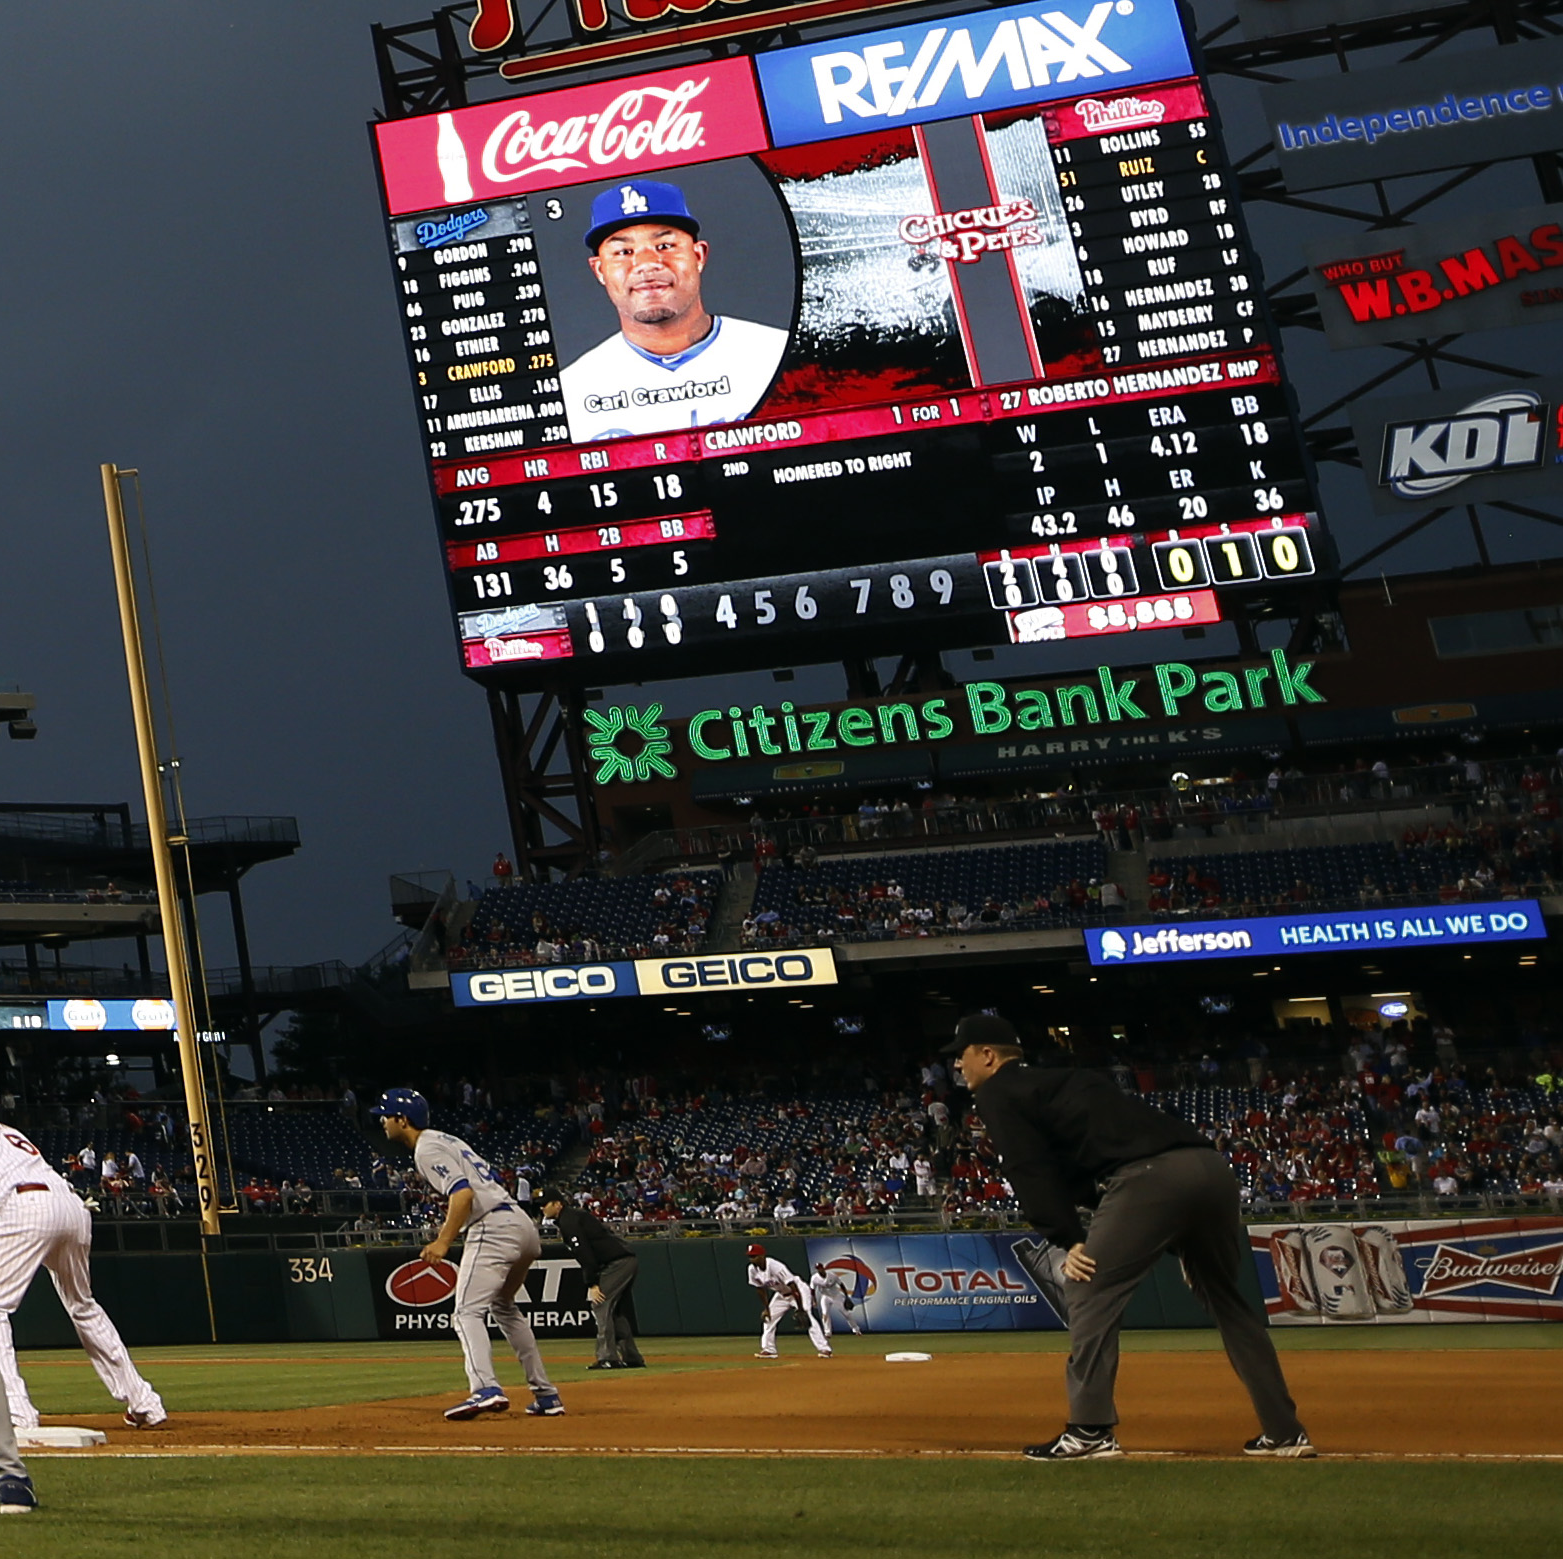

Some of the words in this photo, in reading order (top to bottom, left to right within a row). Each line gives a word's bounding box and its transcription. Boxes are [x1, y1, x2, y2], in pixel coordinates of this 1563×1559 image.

[1075, 97, 1165, 132] Phillies
[1278, 86, 1553, 150] Independence
[482, 76, 706, 183] Coca-Cola
[1054, 148, 1072, 163] 11
[1100, 129, 1161, 154] ROLLINS
[1060, 172, 1077, 187] 51
[1119, 158, 1154, 177] RUIZ
[1065, 196, 1085, 211] 26
[1121, 181, 1165, 202] UTLEY
[416, 207, 489, 248] Dodgers
[899, 199, 1038, 244] CHICKIE'S
[1130, 208, 1169, 228] BYRD
[434, 243, 488, 265] GORDON
[938, 241, 959, 260] &
[957, 226, 1043, 263] PETE'S
[1123, 229, 1188, 255] HOWARD
[439, 267, 492, 289] FIGGINS
[1147, 257, 1177, 277] RUF
[1322, 260, 1363, 281] WHO
[1370, 254, 1404, 273] BUT
[452, 291, 485, 310] PUIG
[1125, 279, 1214, 308] HERNANDEZ
[441, 312, 506, 336] GONZALEZ
[1137, 305, 1214, 332] MAYBERRY
[456, 337, 500, 357] ETHIER
[1137, 330, 1228, 358] HERNANDEZ
[447, 357, 515, 381] CRAWFORD
[469, 384, 502, 403] ELLIS
[584, 392, 628, 414] Carl
[632, 376, 730, 406] Crawford
[1000, 391, 1022, 409] 27
[1028, 378, 1109, 406] ROBERTO
[1113, 363, 1223, 394] HERNANDEZ
[1227, 360, 1259, 379] RHP
[447, 404, 535, 431] ARRUEBARRENA
[912, 406, 940, 422] FOR
[1148, 405, 1186, 427] ERA
[1231, 396, 1259, 416] BB
[465, 430, 524, 453] KERSHAW
[704, 421, 802, 450] CRAWFORD
[1150, 432, 1198, 458] 4.12
[1240, 422, 1268, 445] 18
[1389, 408, 1541, 478] KDI
[456, 468, 490, 487] AVG
[524, 459, 549, 478] HR
[580, 450, 609, 470] RBI
[722, 462, 749, 476] 2ND
[774, 462, 842, 484] HOMERED
[454, 498, 501, 526] .275
[590, 482, 618, 508] 15
[654, 474, 682, 500] 18
[1031, 512, 1077, 537] 43.2
[1107, 505, 1135, 528] 46
[1179, 496, 1207, 519] 20
[1254, 488, 1284, 511] 36
[476, 542, 498, 561] AB
[598, 528, 621, 546] 2B
[660, 520, 684, 538] BB
[474, 572, 512, 598] 131
[544, 565, 573, 590] 36
[688, 698, 954, 761] Citizens
[966, 665, 1146, 738] Bank
[1154, 648, 1326, 718] Park
[997, 737, 1110, 759] HARRY
[1120, 734, 1160, 747] THE
[1170, 726, 1222, 744] K'S
[1131, 928, 1251, 956] Jefferson
[1280, 922, 1370, 946] HEALTH
[1375, 921, 1395, 939] IS
[1400, 918, 1443, 939] ALL
[1445, 915, 1485, 935] WE
[1490, 911, 1528, 932] DO
[469, 966, 616, 1002] GEICO
[661, 955, 814, 989] GEICO
[68, 1008, 103, 1022] Gulf
[136, 1008, 172, 1021] Gulf
[191, 1121, 212, 1213] 329
[288, 1257, 334, 1284] 334
[886, 1266, 1025, 1292] TOTAL
[894, 1296, 969, 1306] PERFORMANCE
[973, 1296, 1011, 1305] ENGINE
[1014, 1294, 1037, 1304] OILS
